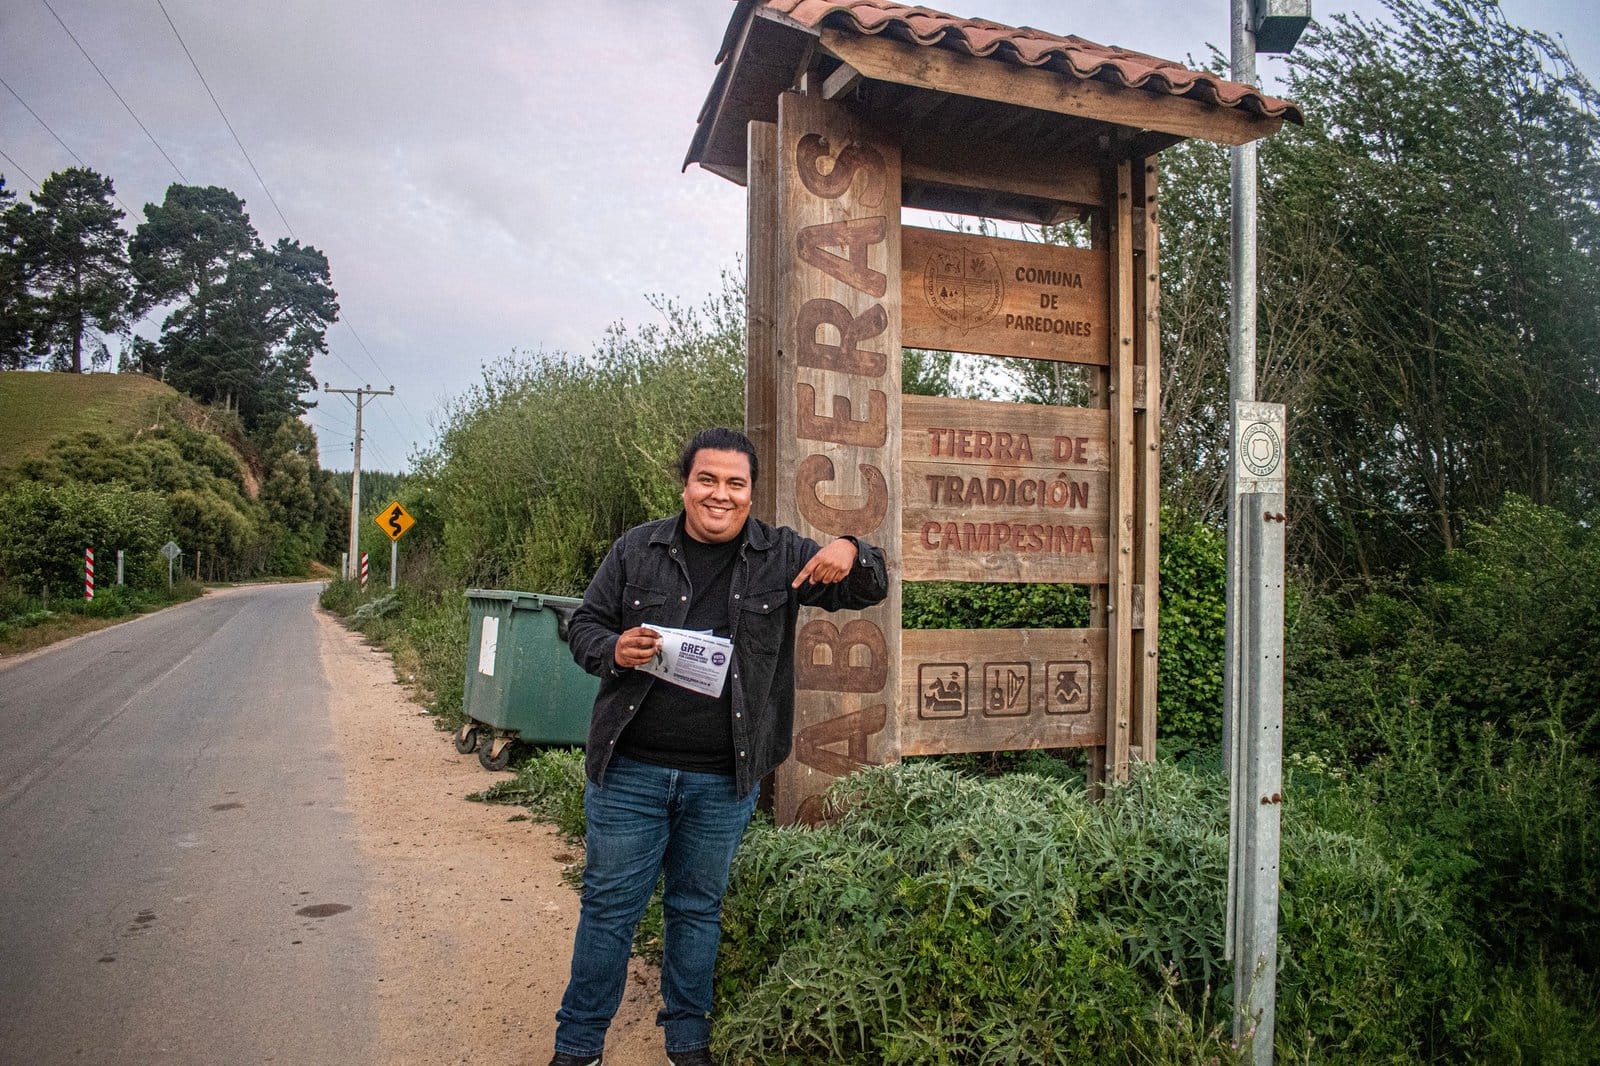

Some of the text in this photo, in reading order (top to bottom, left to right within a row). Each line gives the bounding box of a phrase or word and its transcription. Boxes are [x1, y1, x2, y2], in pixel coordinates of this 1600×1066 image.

[1015, 267, 1082, 289] COMUNA
[1040, 293, 1058, 310] DE
[1005, 314, 1091, 337] PAREDONES
[928, 428, 1089, 464] TIERRA DE
[797, 133, 888, 828] ABCERAS
[926, 472, 1089, 509] TRADICIÓN
[920, 521, 1094, 553] CAMPESINA
[680, 642, 706, 656] GREZ
